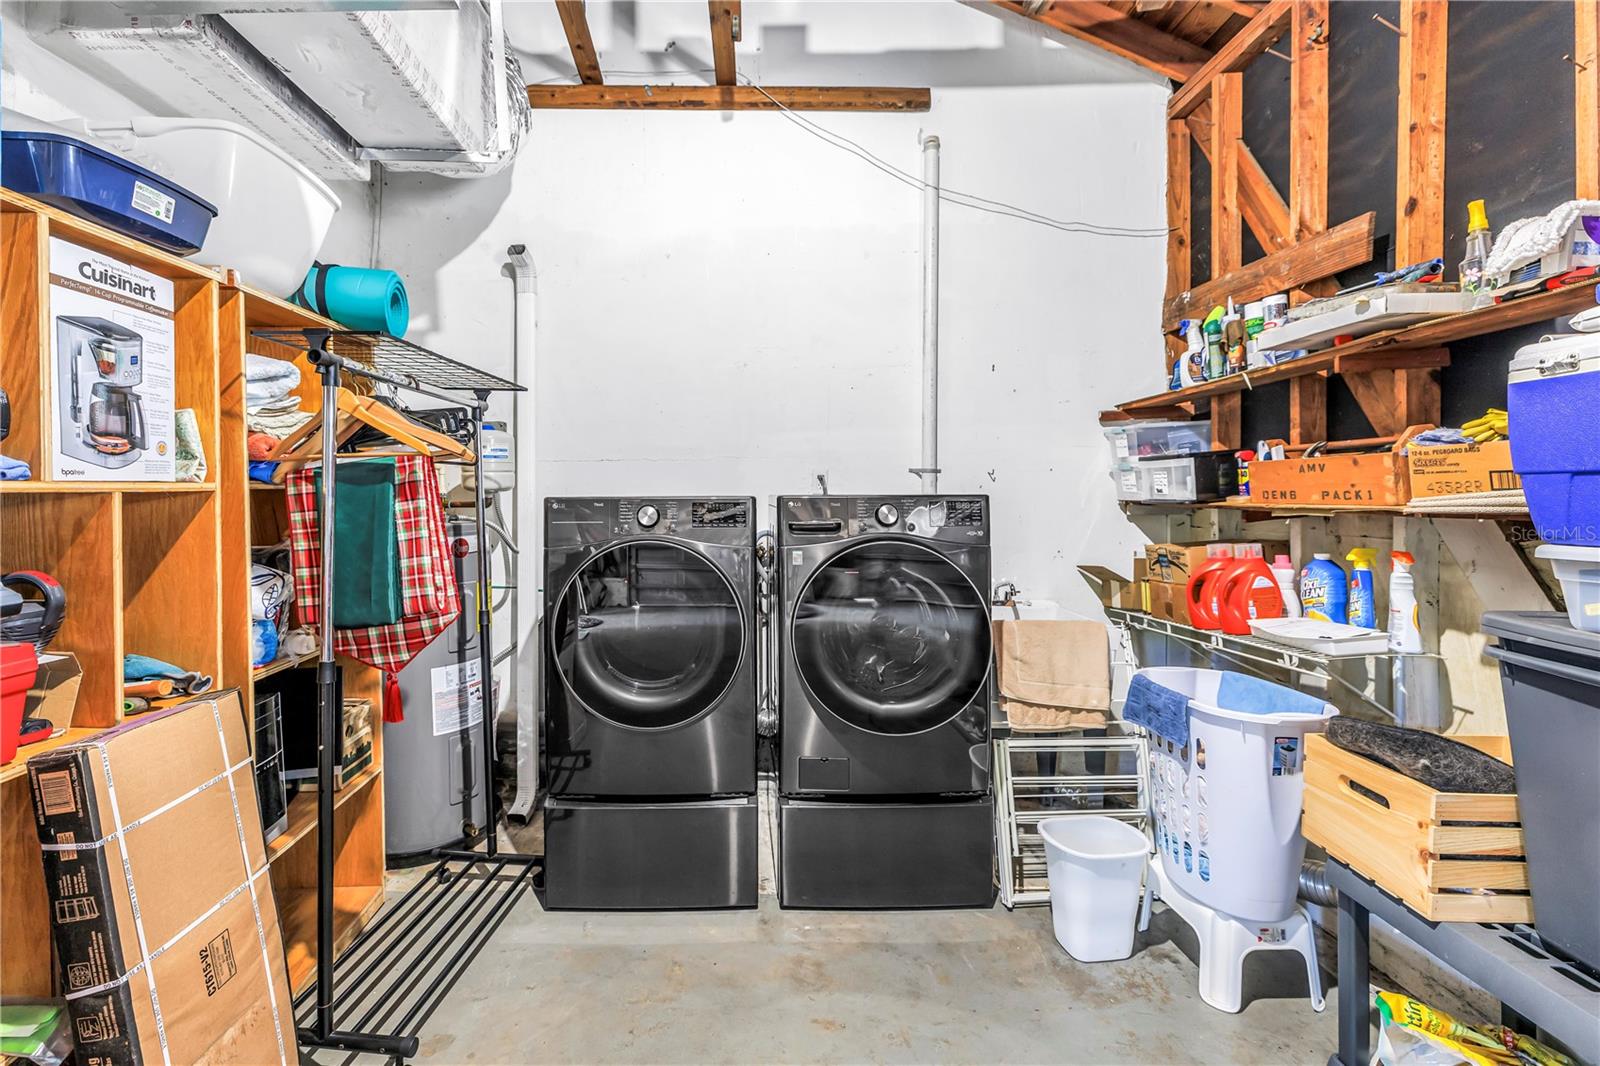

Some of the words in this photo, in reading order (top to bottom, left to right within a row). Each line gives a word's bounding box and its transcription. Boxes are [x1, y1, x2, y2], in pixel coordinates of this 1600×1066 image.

[78, 261, 156, 301] Cuisinart
[1432, 447, 1463, 455] PEGBOARD
[1299, 463, 1326, 473] AMV
[199, 946, 217, 997] CT615-V2
